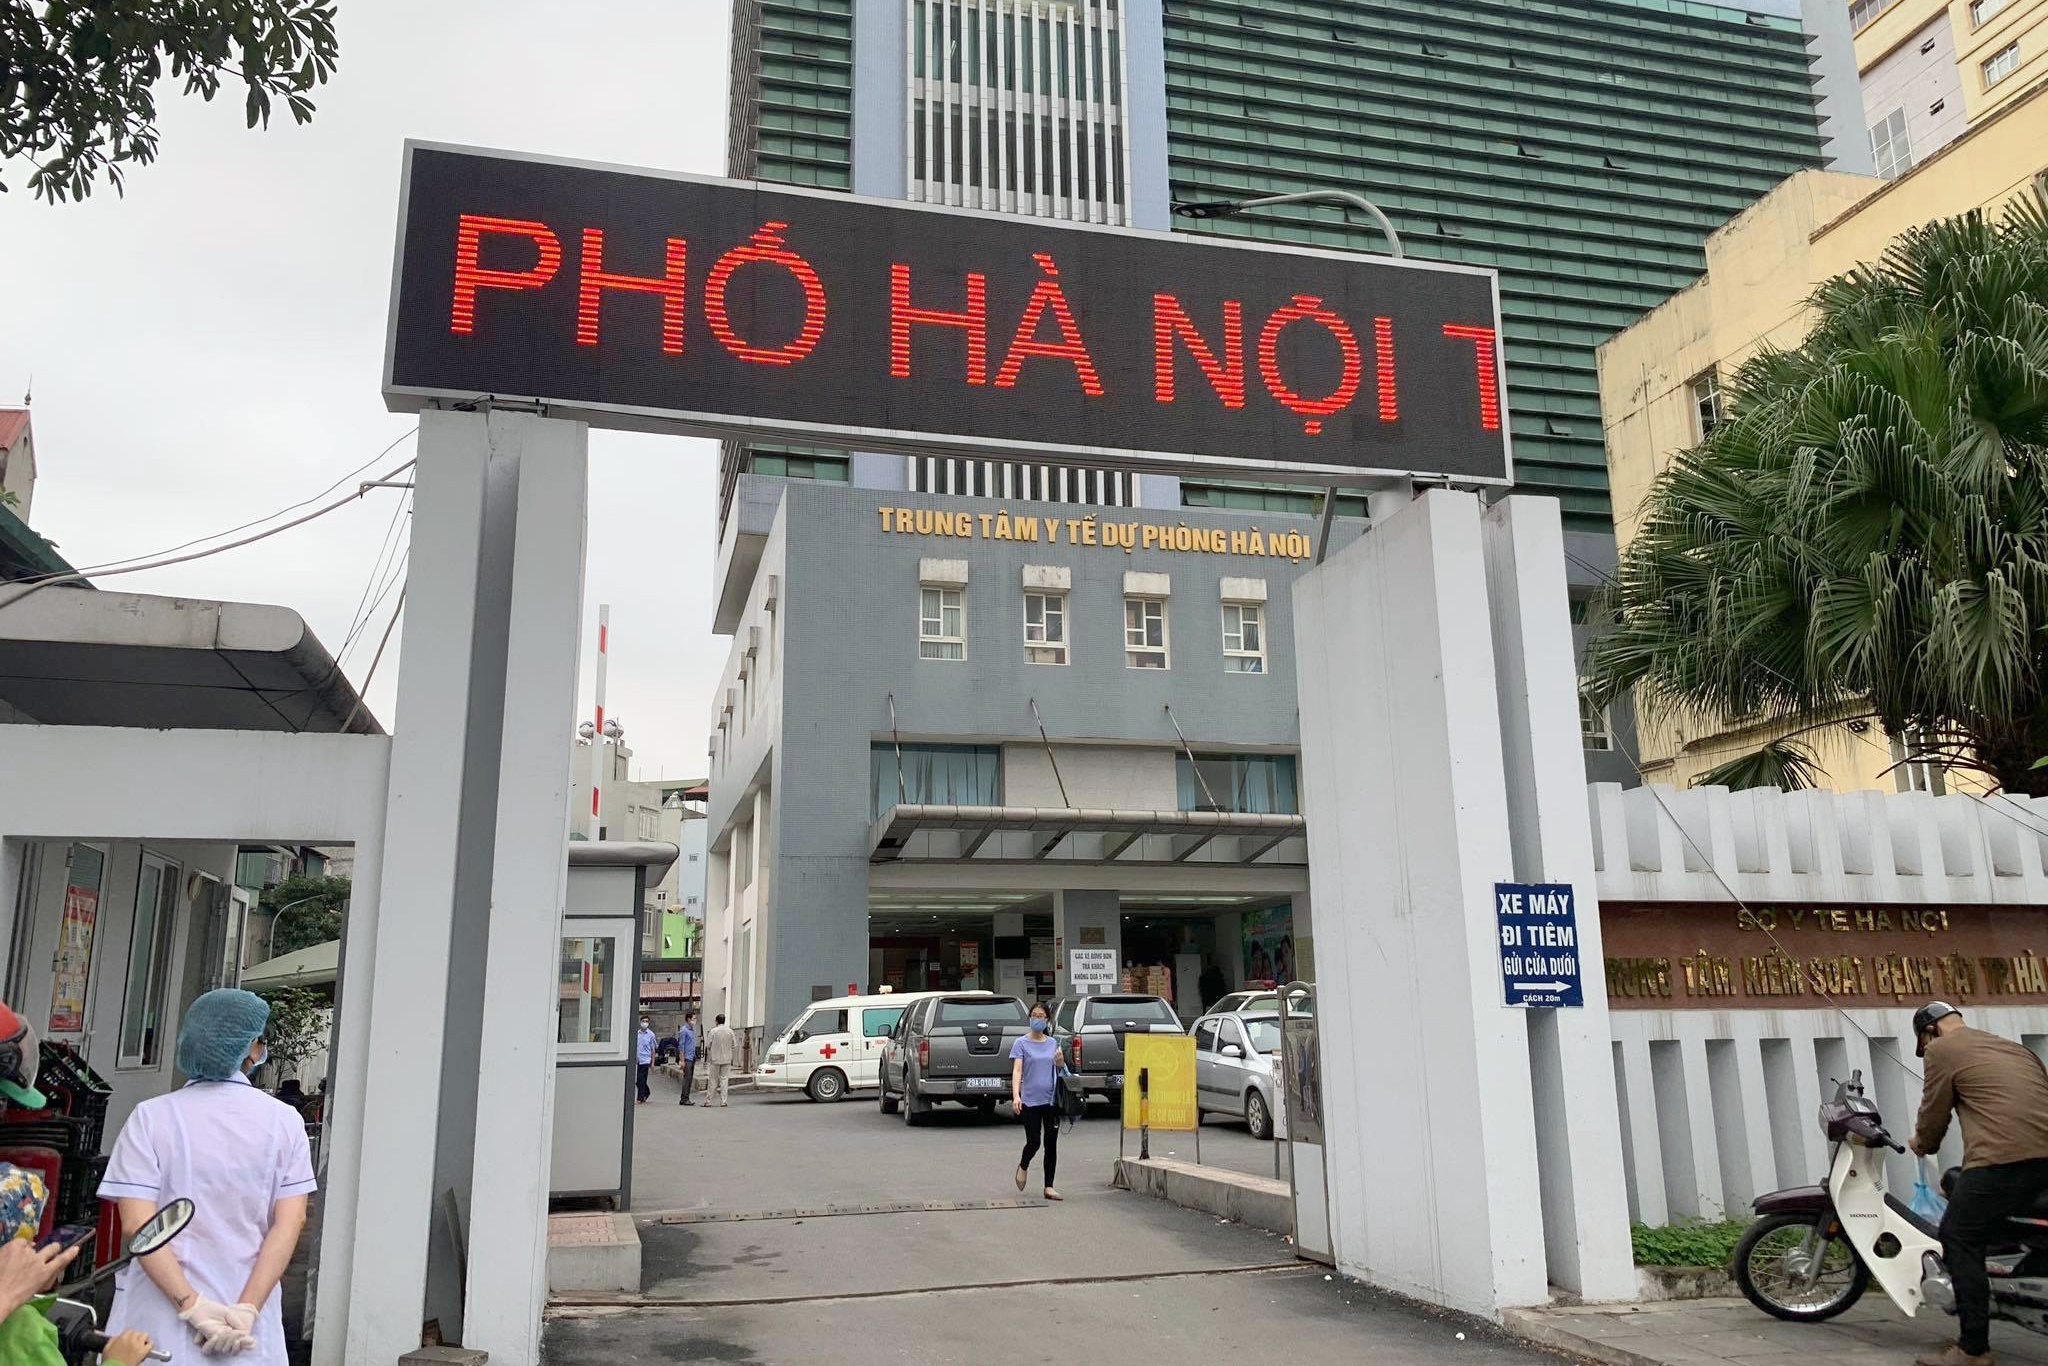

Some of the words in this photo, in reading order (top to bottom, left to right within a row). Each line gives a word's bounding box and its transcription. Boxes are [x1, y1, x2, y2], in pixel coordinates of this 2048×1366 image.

[451, 214, 826, 365] PHỐ
[890, 252, 1104, 396] HÀ
[1154, 293, 1398, 435] NỘI
[878, 506, 972, 537] TRUNG
[978, 510, 1038, 542] TÂM
[1043, 518, 1062, 543] Y
[1066, 513, 1099, 546] TẾ
[1102, 521, 1141, 554] DỰ
[1142, 521, 1227, 554] PHÒNG
[1231, 525, 1266, 557] HÀ
[1269, 532, 1311, 565] NỘI
[1499, 893, 1523, 914] XE
[1528, 889, 1569, 915] MÁY
[1786, 908, 1805, 932] Y
[1502, 925, 1522, 946] ĐI
[1527, 921, 1574, 947] TIÊM
[1504, 951, 1523, 976] GỬI
[1525, 951, 1548, 976] CỬA
[1550, 952, 1576, 976] DƯỚI
[1606, 956, 1673, 998] RUNG
[1679, 948, 1737, 997] TÂM
[1872, 950, 1934, 1001] BỆNH
[1522, 993, 1544, 1002] CÁCH
